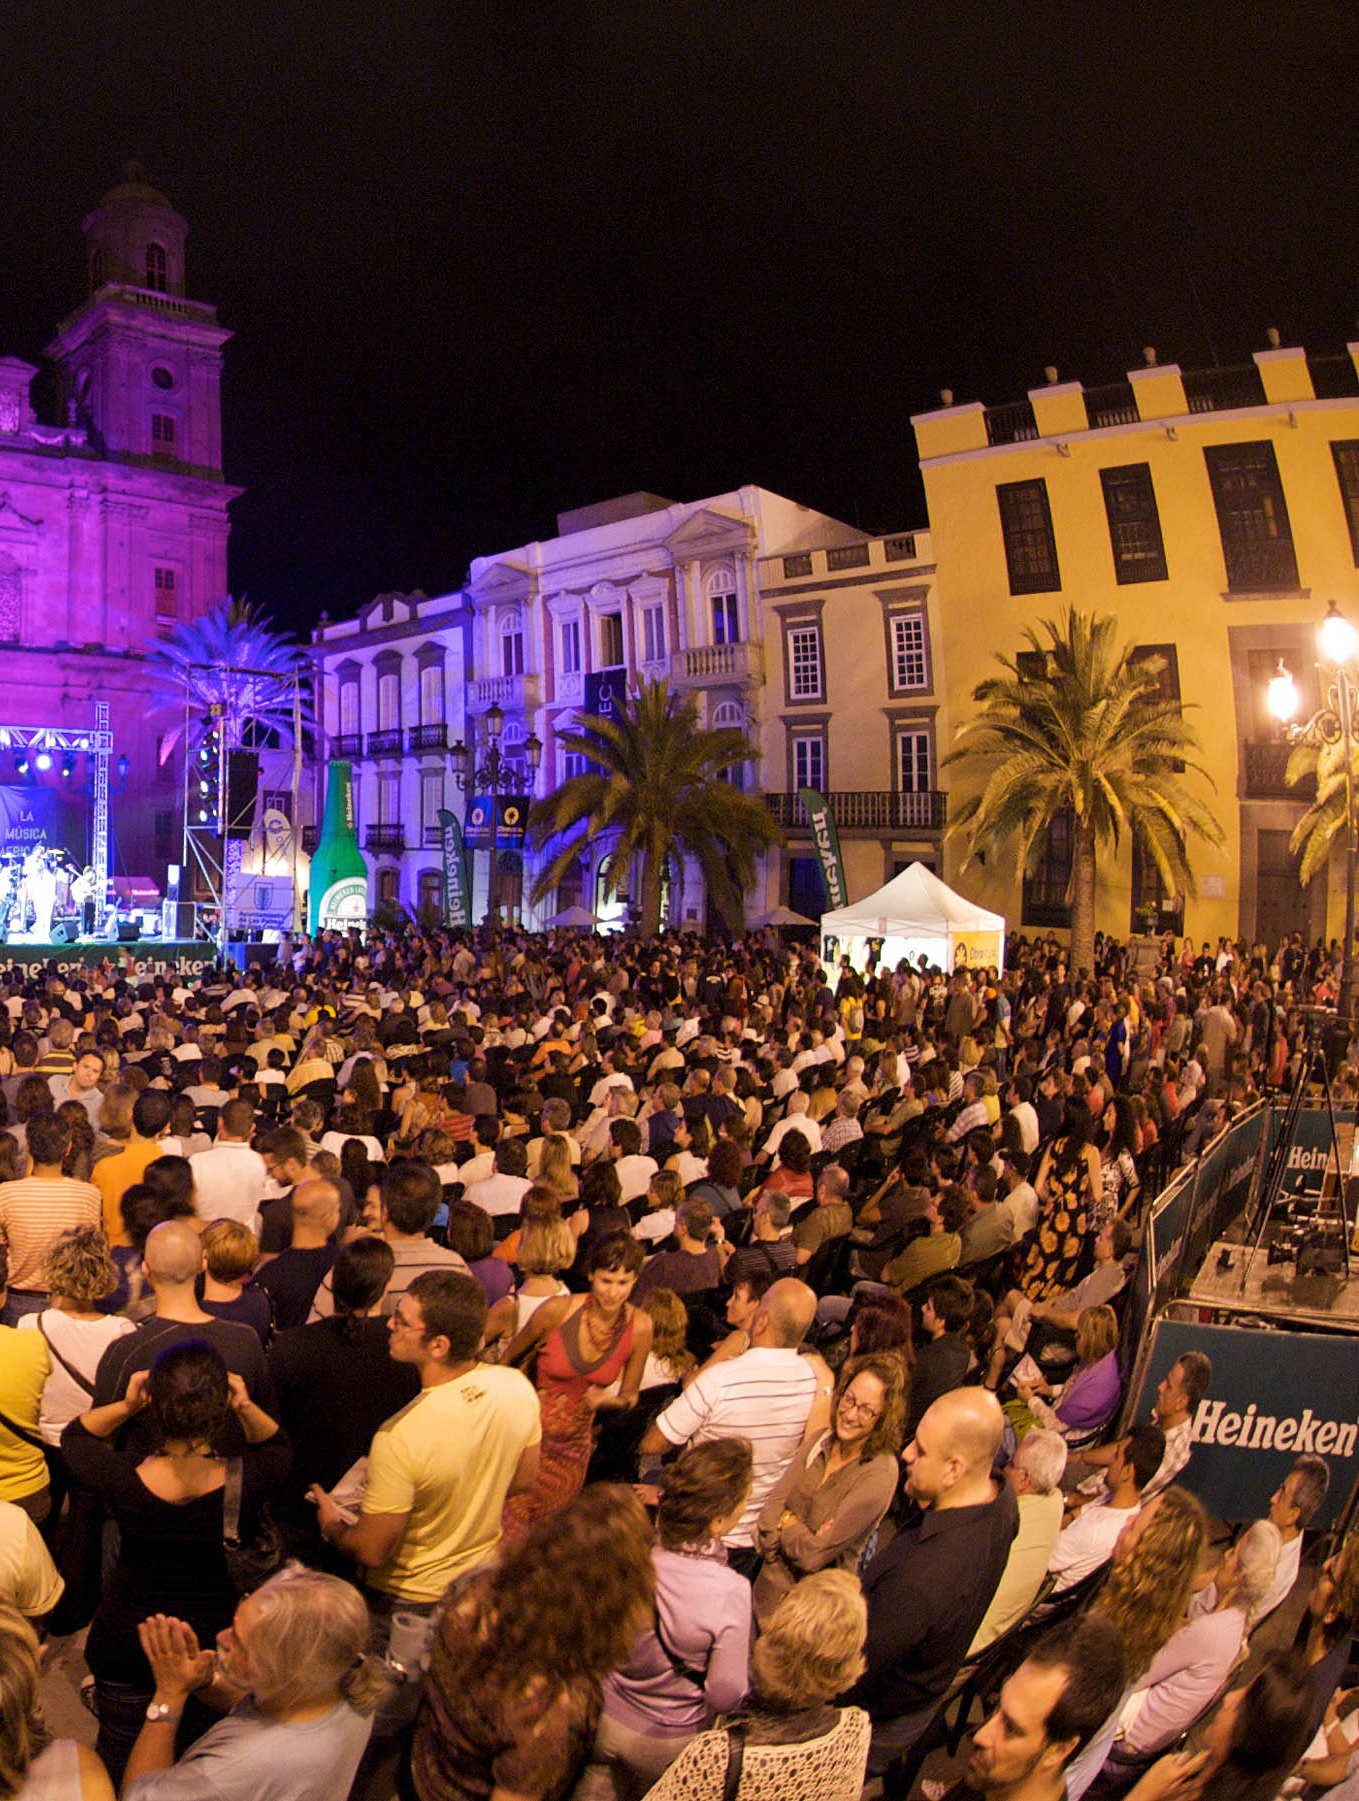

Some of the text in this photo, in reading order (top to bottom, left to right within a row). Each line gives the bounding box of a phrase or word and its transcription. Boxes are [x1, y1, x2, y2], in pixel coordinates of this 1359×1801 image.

[5, 825, 47, 839] MÚSICA
[20, 810, 34, 821] LA
[445, 825, 467, 927] Heineken
[1192, 1399, 1358, 1457] Heineken
